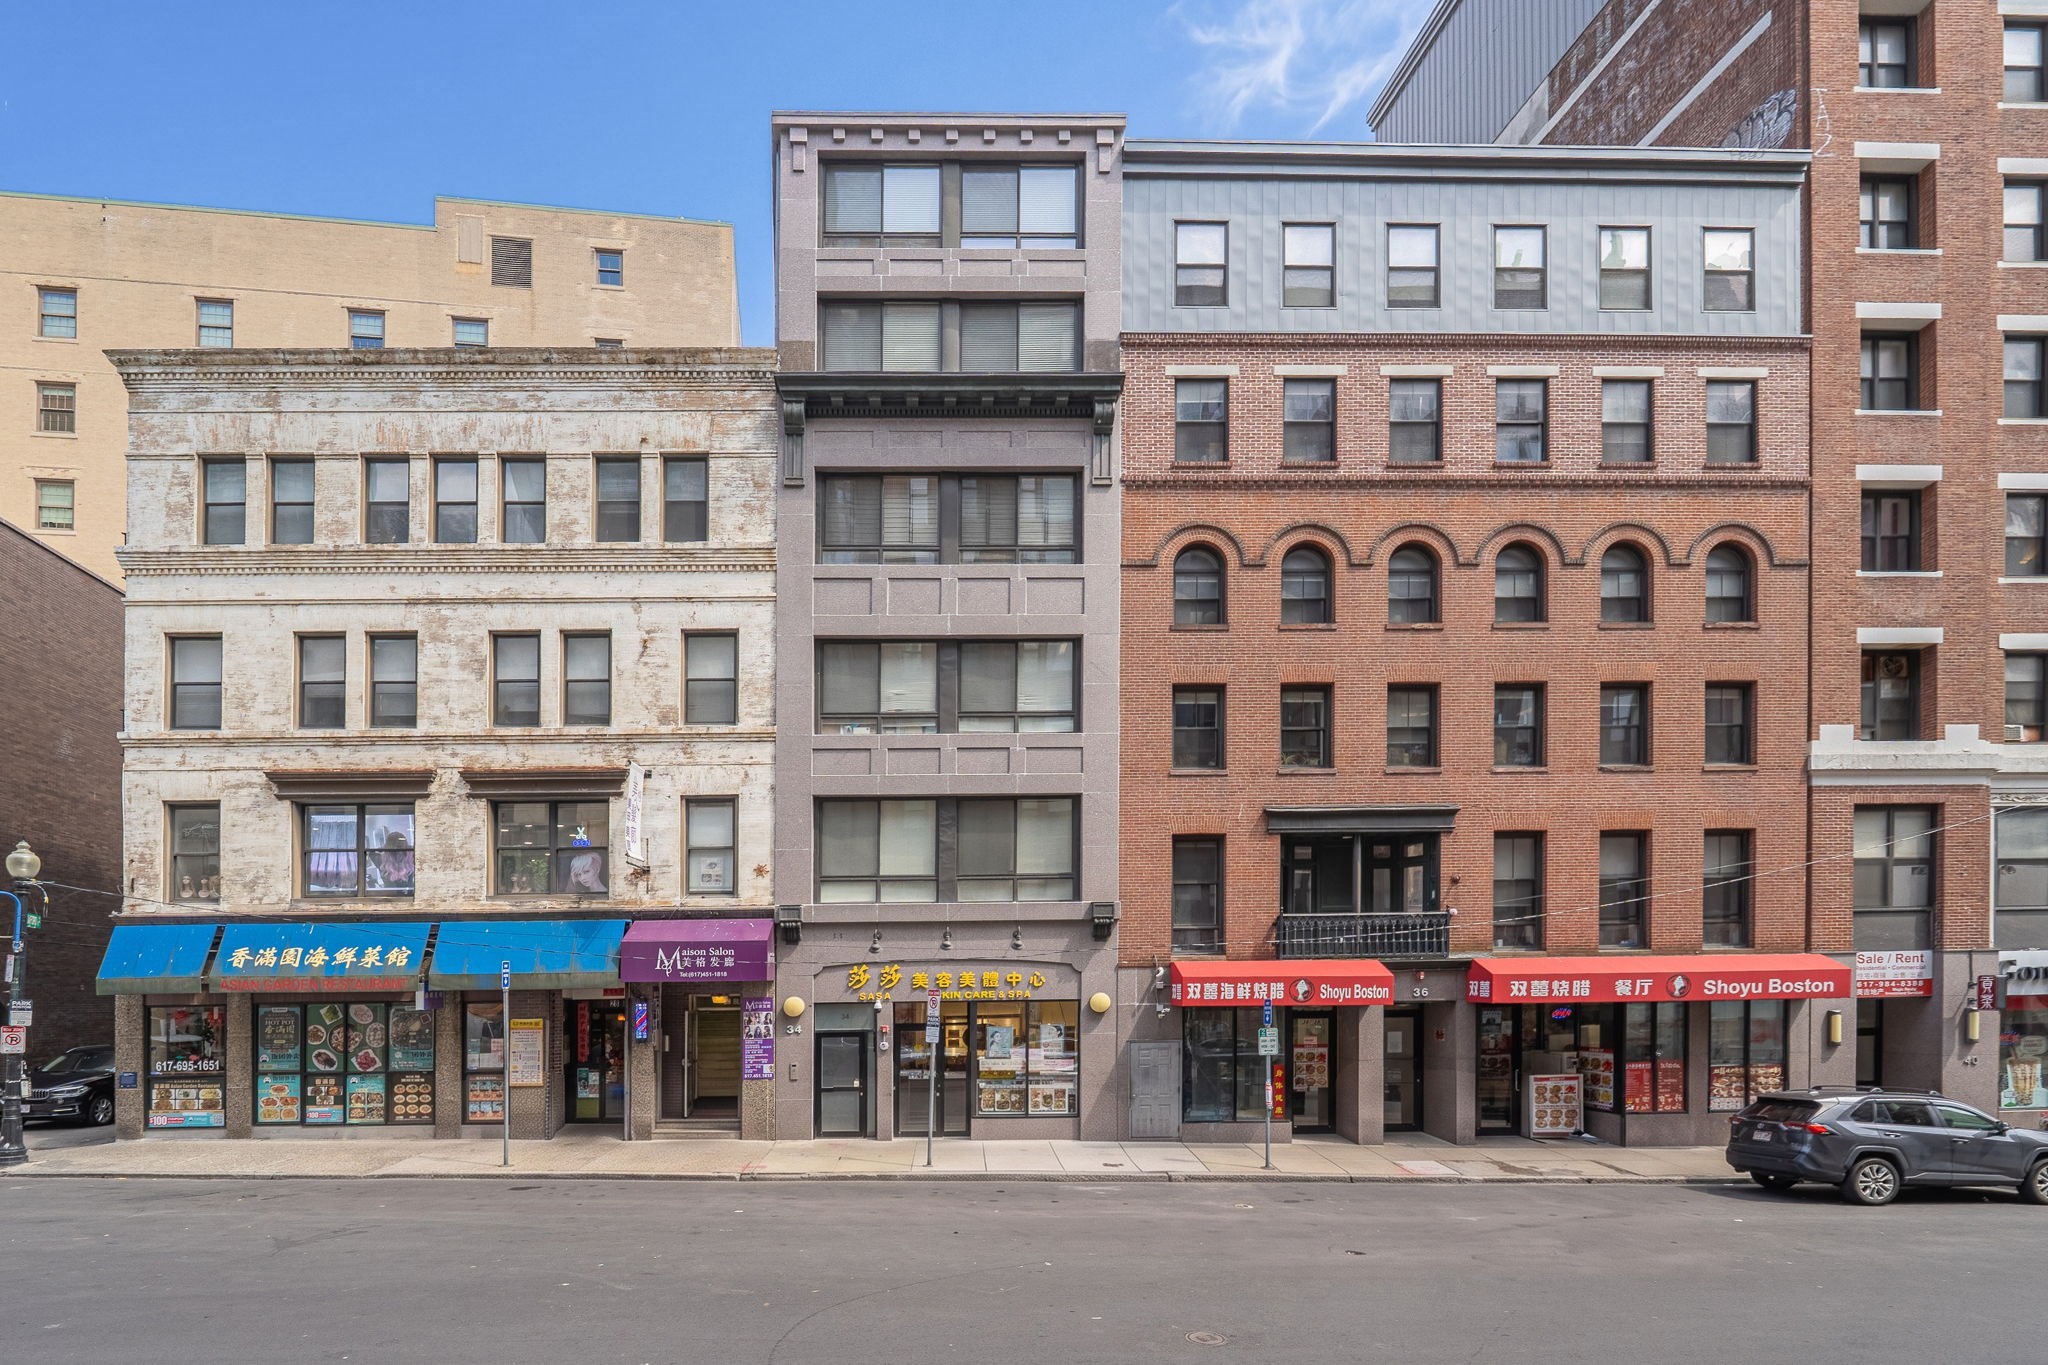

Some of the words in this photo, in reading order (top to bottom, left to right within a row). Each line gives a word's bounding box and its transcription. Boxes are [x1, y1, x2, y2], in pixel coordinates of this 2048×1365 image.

[709, 947, 735, 956] Salon
[1857, 954, 1884, 964] Sale
[1896, 954, 1924, 963] Rent
[848, 964, 902, 989] 莎莎
[912, 970, 1046, 989] 美容美體中心
[220, 979, 259, 991] ASIAN
[263, 978, 319, 991] GARDEN
[322, 978, 408, 990] RESTAURANT
[1614, 979, 1653, 996] 餐厅
[1704, 980, 1762, 998] Shoyu
[1768, 978, 1835, 993] Boston
[859, 992, 891, 1000] SASA
[941, 991, 961, 999] KIN
[964, 990, 996, 999] CARE
[998, 990, 1005, 999] &
[1008, 990, 1031, 998] SPA
[1320, 984, 1351, 1002] Shoyu
[1353, 984, 1389, 999] Boston
[1413, 988, 1429, 997] 36
[786, 1025, 802, 1034] 34
[156, 1060, 220, 1071] 617-695-1651
